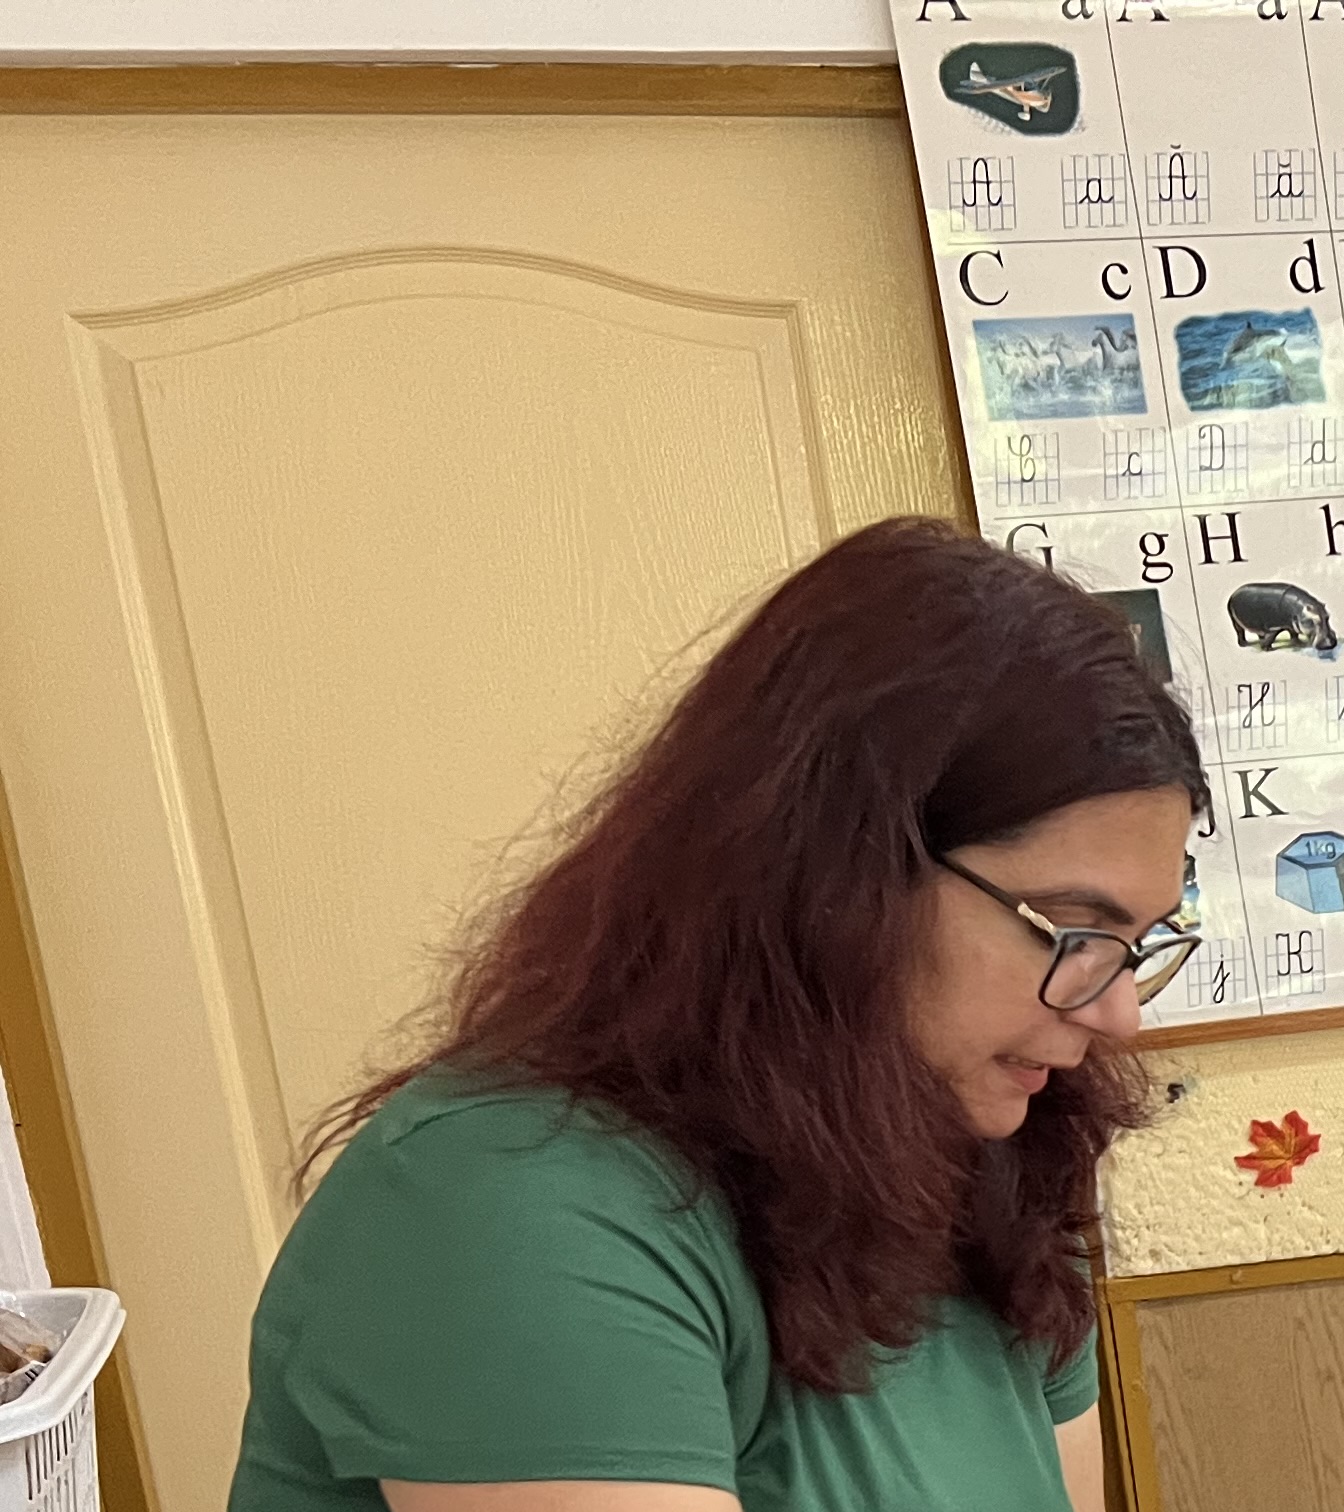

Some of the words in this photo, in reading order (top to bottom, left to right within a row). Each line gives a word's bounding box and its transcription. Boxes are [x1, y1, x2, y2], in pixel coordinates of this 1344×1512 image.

[962, 158, 1002, 207] A
[1079, 178, 1114, 204] a
[1159, 145, 1197, 201] Ă
[1270, 163, 1304, 198] ă
[960, 250, 1008, 305] C
[1102, 263, 1131, 300] c
[1153, 245, 1207, 299] D
[1290, 239, 1324, 293] d
[1007, 434, 1037, 484] C
[1122, 452, 1142, 476] c
[1199, 424, 1225, 472] D
[1304, 419, 1336, 464] d
[1000, 523, 1056, 575] G
[1139, 533, 1173, 583] g
[1196, 512, 1245, 564] H
[1238, 682, 1269, 728] H
[1232, 766, 1289, 820] K
[1213, 953, 1231, 1004] j
[1276, 931, 1313, 976] K
